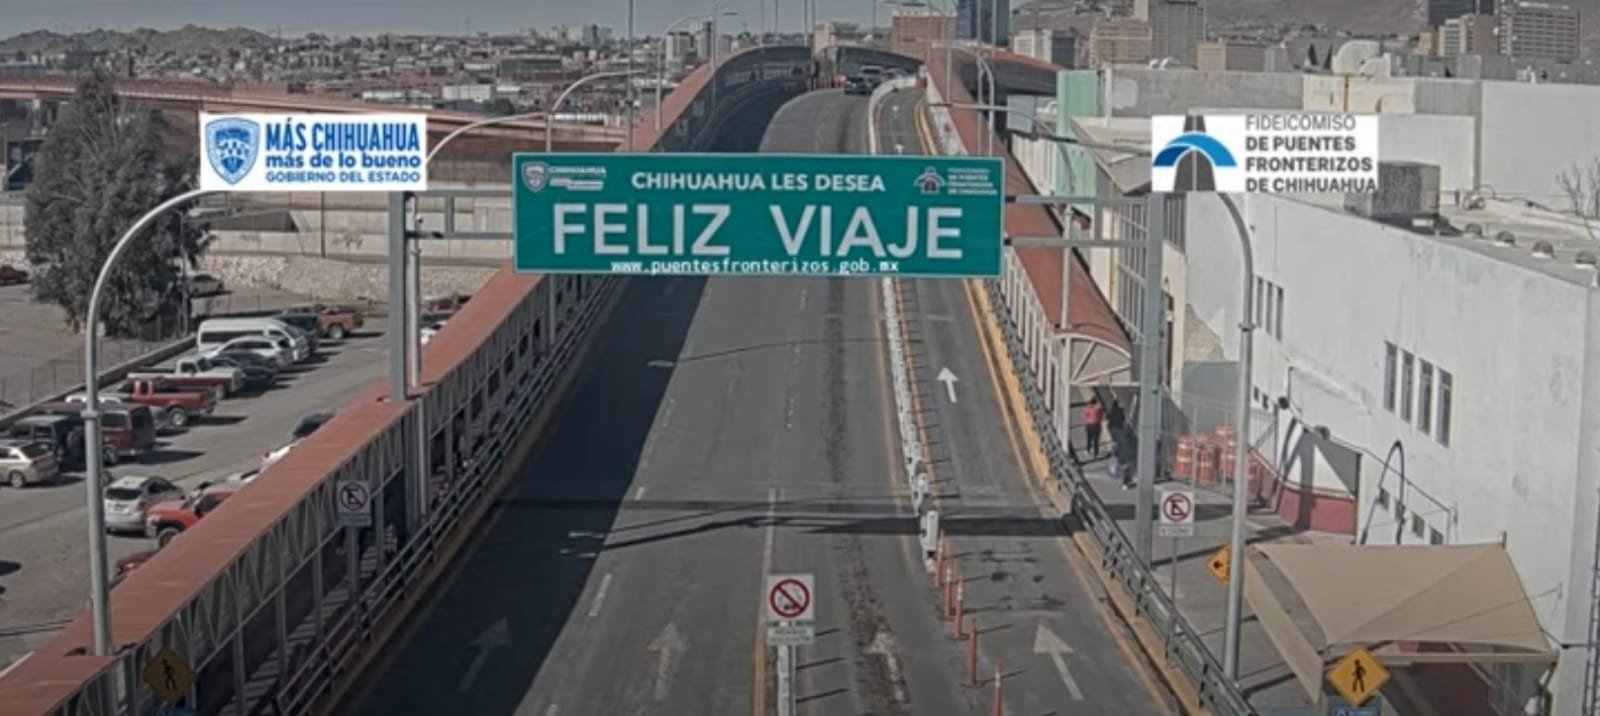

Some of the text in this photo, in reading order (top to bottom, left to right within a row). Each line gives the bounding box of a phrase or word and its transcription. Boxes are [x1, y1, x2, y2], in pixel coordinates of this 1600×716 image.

[631, 171, 886, 192] CHIHUAHUA LES DESEA
[553, 203, 963, 259] FELIZ VIAJE
